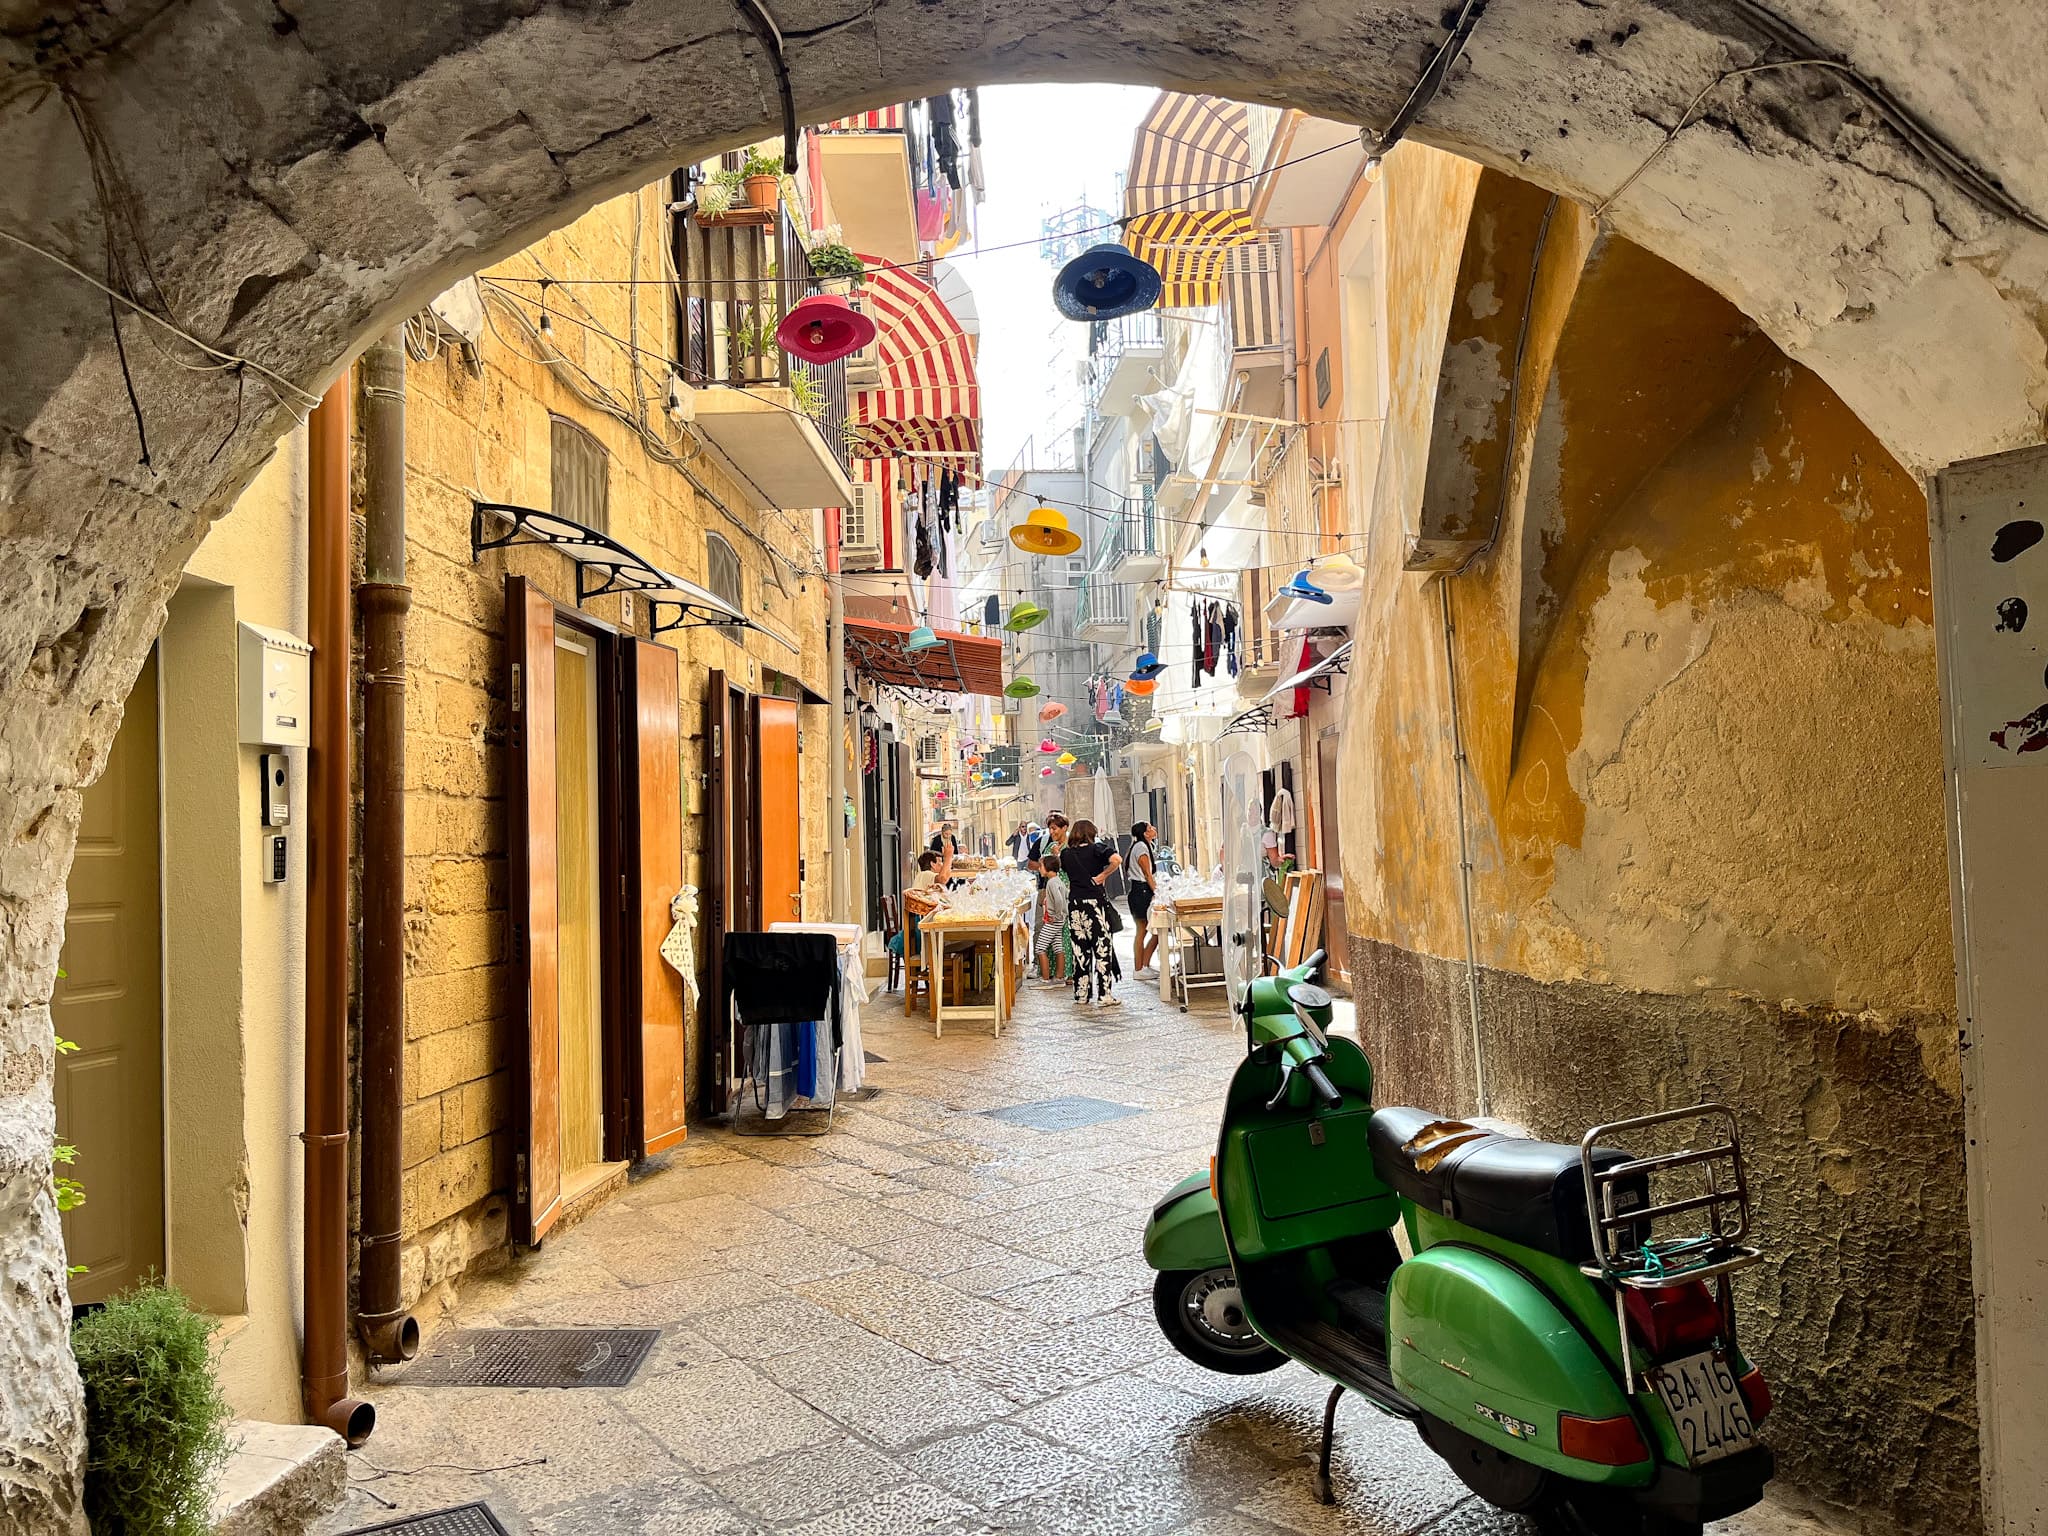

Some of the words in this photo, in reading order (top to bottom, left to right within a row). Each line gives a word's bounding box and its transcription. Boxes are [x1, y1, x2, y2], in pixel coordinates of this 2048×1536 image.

[625, 596, 632, 617] 5
[1661, 1368, 1702, 1412] BA
[1700, 1359, 1734, 1398] 16
[1498, 1413, 1522, 1431] 125
[1522, 1422, 1537, 1437] E
[1682, 1402, 1751, 1459] 2446
